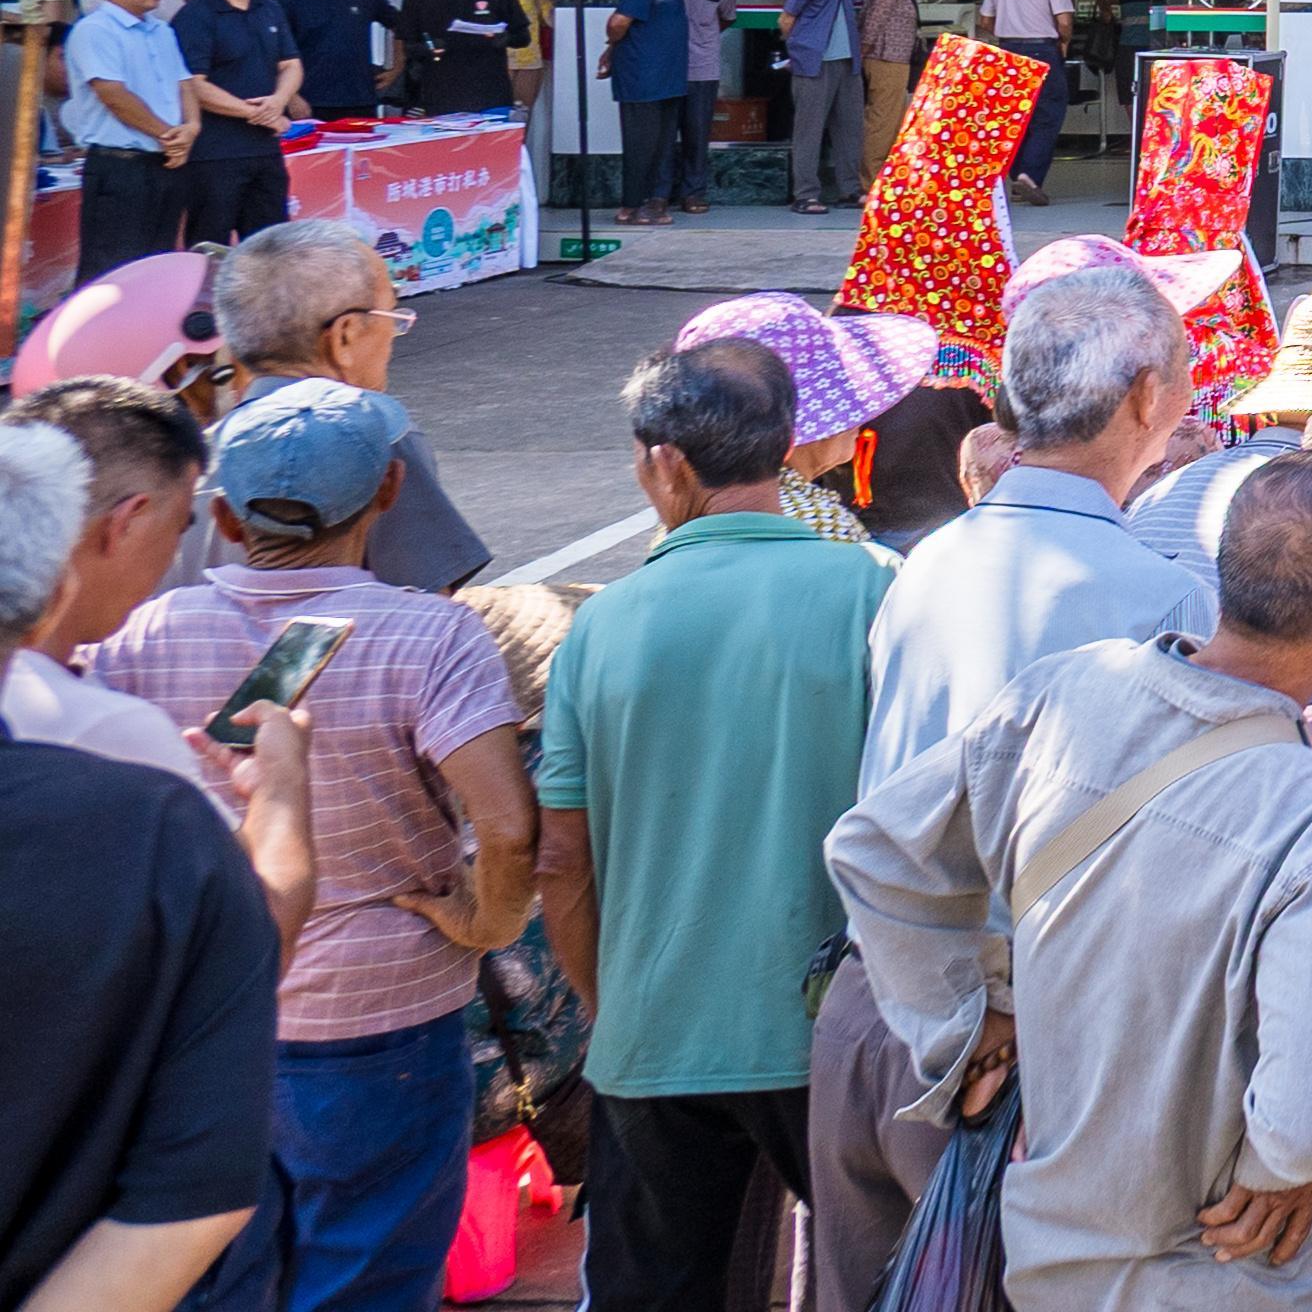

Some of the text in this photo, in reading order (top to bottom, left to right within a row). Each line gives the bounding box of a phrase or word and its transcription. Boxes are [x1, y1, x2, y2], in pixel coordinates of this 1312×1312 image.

[386, 167, 491, 204] 防城港市打私办
